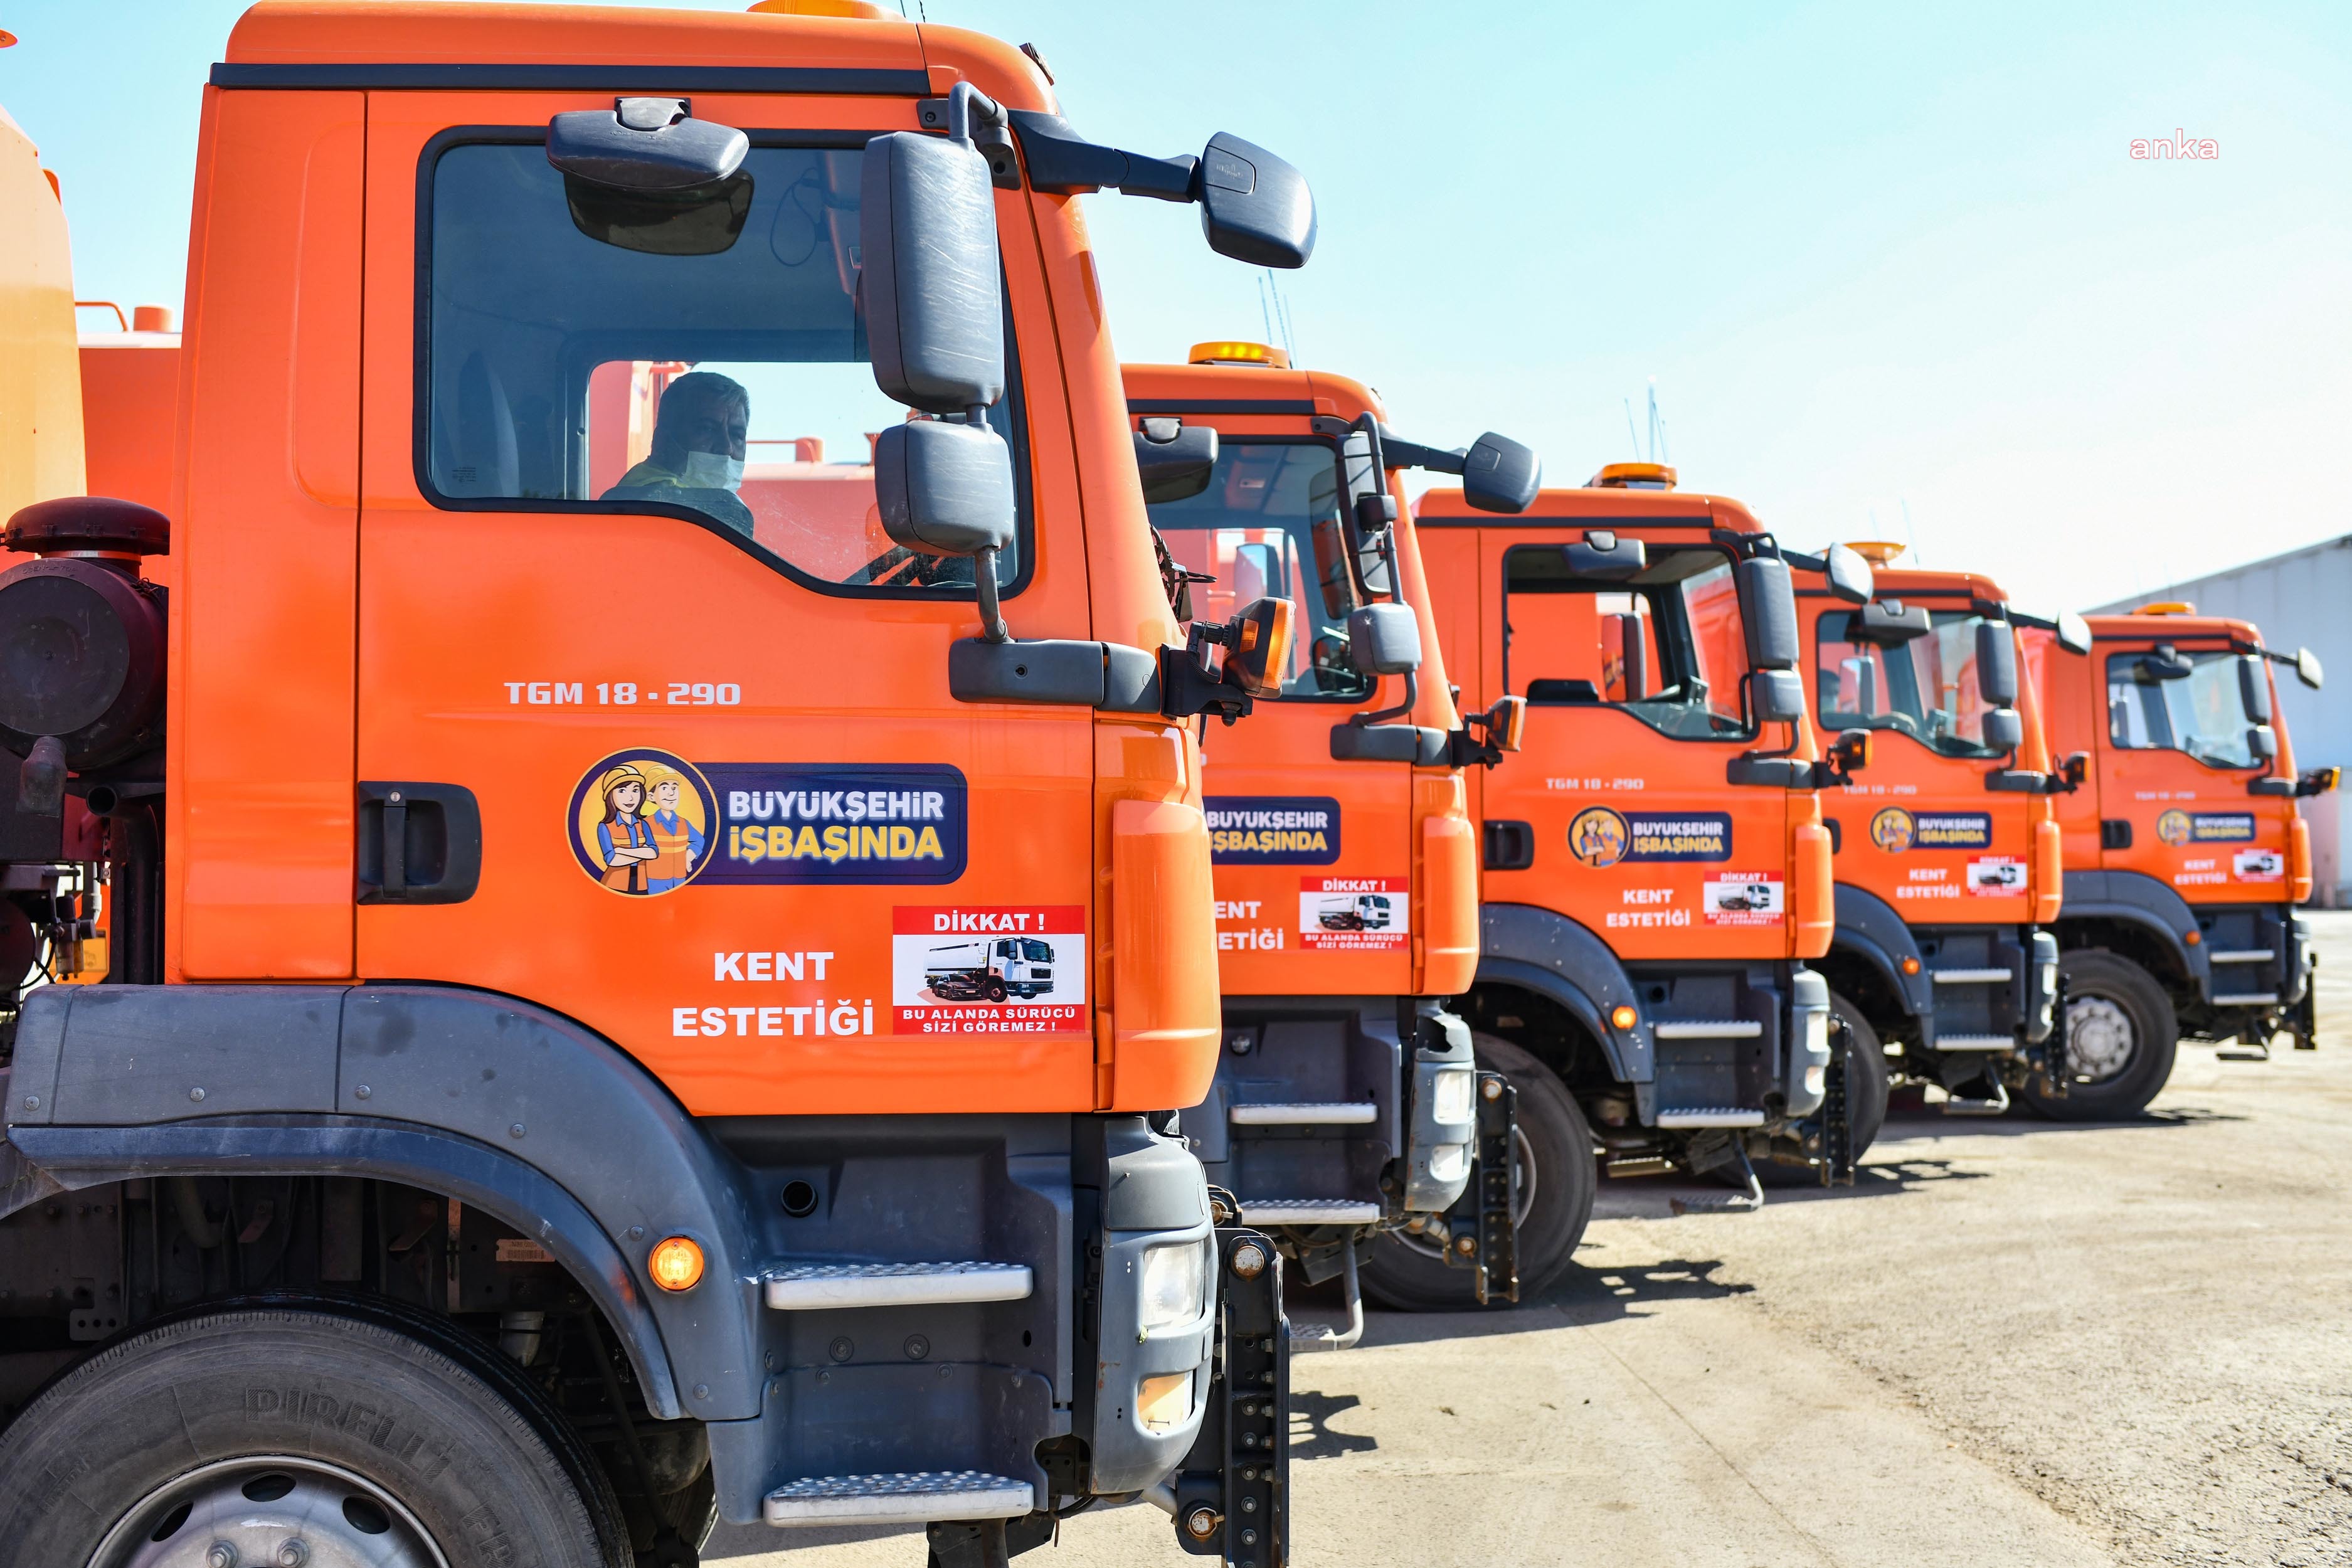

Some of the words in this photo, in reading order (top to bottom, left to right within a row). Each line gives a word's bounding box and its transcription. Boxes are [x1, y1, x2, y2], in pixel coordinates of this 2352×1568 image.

[504, 682, 583, 704] TGM
[596, 682, 637, 704] 18
[667, 683, 740, 705] 290
[1323, 878, 1377, 891] DİKKAT
[1623, 889, 1674, 904] KENT
[934, 910, 1030, 931] DİKKAT
[1214, 901, 1262, 919] ENT
[1217, 928, 1284, 950] ETİĞİ
[714, 952, 834, 981] KENT
[673, 999, 873, 1036] ESTETİĞİ
[903, 1010, 925, 1019] BU
[931, 1009, 1000, 1019] ALANDA
[1005, 1007, 1075, 1019] SÜRÜCÜ
[923, 1021, 956, 1032] SİZİ
[963, 1021, 1046, 1032] GÖREMEZ
[245, 1387, 450, 1484] PIRELLI
